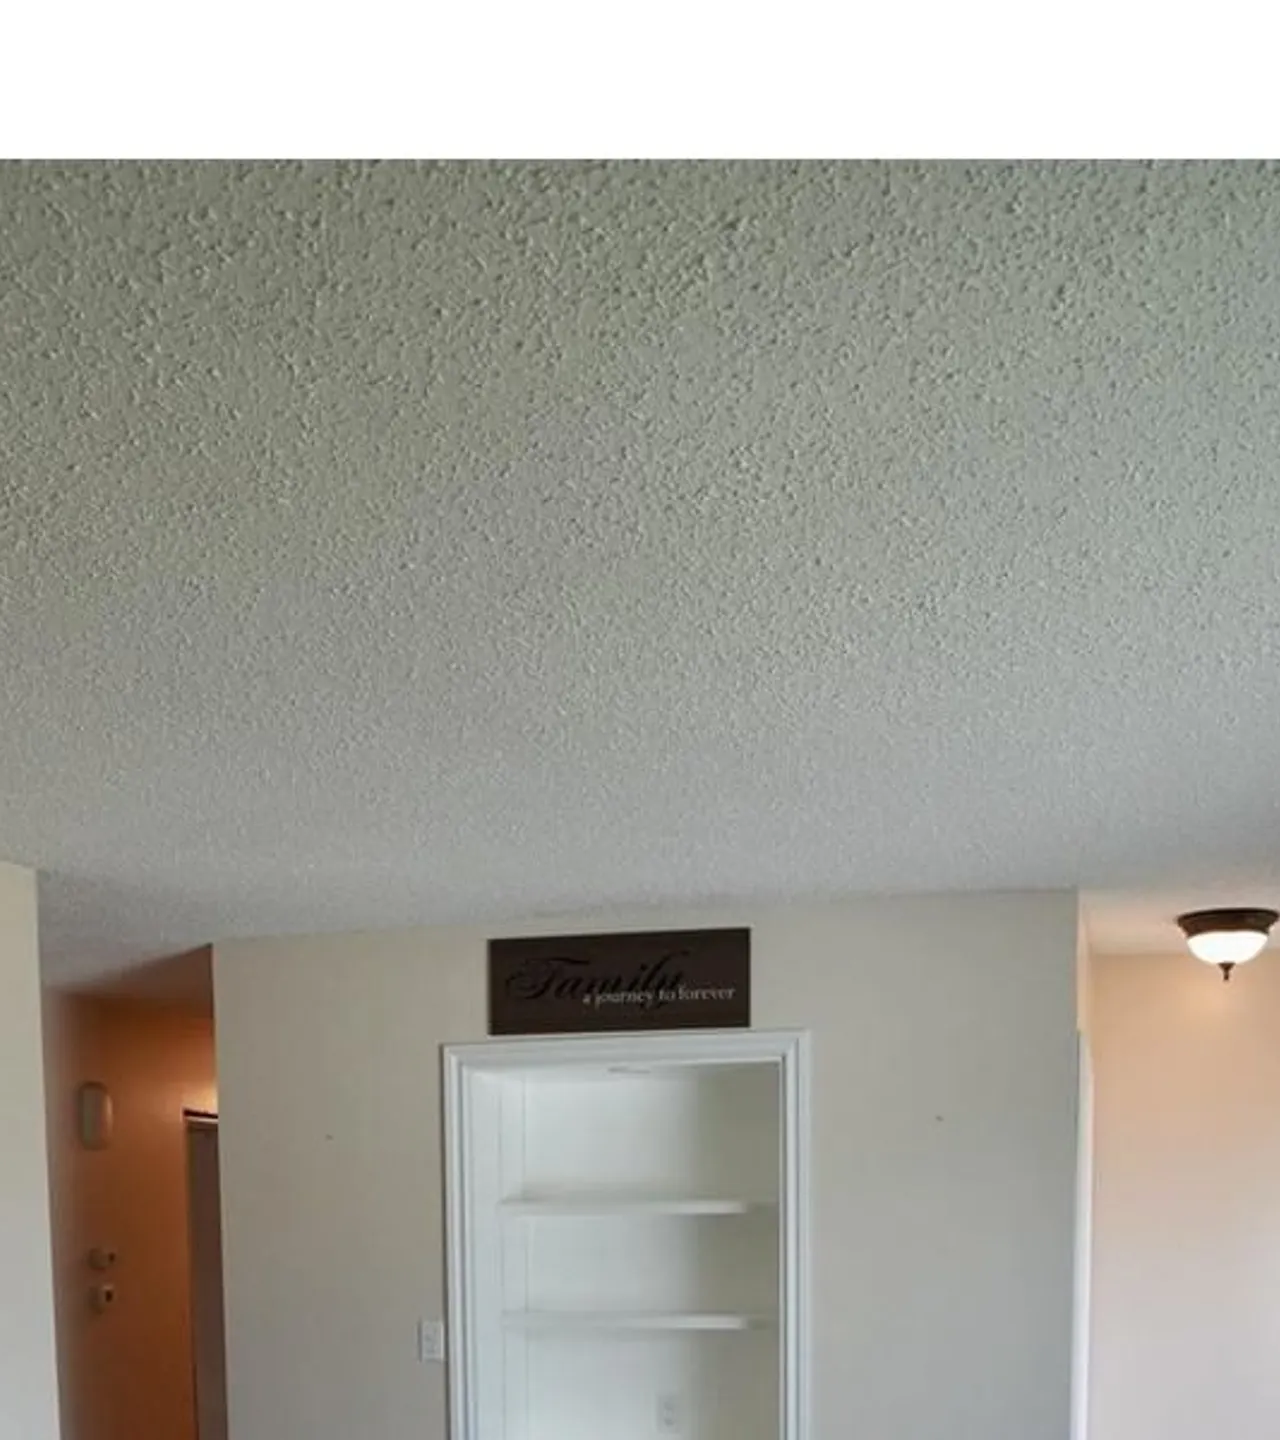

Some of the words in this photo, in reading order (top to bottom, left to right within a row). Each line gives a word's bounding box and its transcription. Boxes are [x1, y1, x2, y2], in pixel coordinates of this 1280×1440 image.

[506, 950, 689, 1010] Family
[594, 991, 653, 1010] journey
[658, 987, 677, 1001] to
[678, 985, 736, 1000] forever
